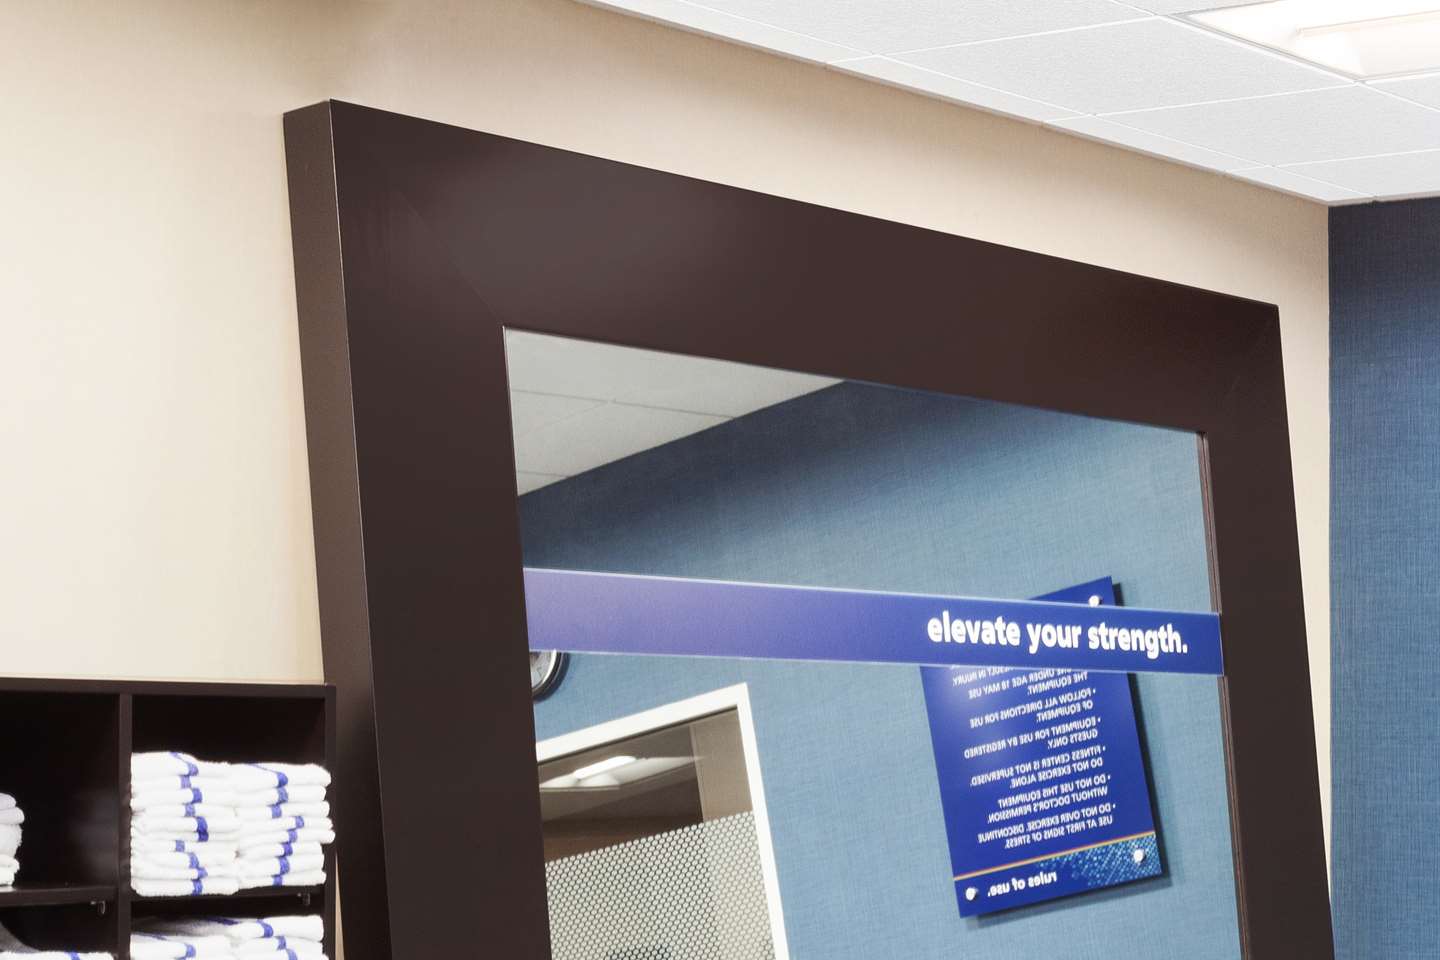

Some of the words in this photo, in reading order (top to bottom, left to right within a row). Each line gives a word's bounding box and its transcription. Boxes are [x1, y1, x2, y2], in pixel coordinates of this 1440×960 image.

[927, 610, 1021, 646] elevate
[1026, 622, 1081, 654] your
[1088, 622, 1188, 659] strength.
